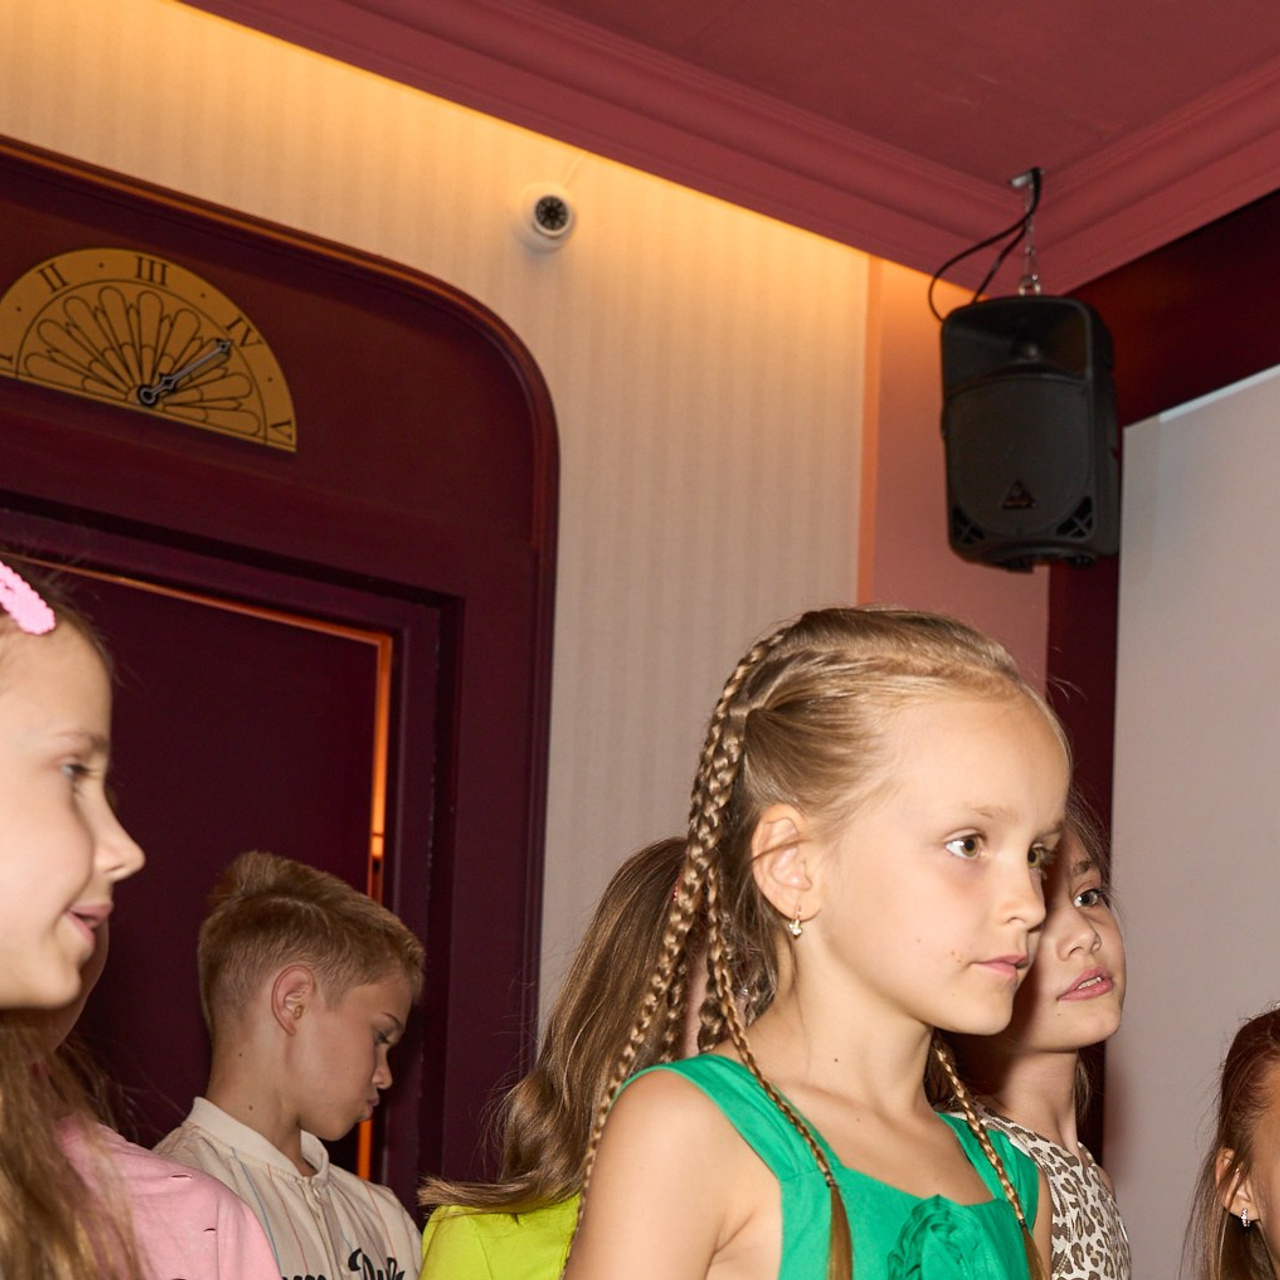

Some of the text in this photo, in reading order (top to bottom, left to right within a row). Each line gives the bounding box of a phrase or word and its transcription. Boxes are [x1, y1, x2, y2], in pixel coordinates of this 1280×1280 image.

[37, 262, 70, 292] II
[136, 256, 168, 287] III
[225, 314, 262, 348] IV
